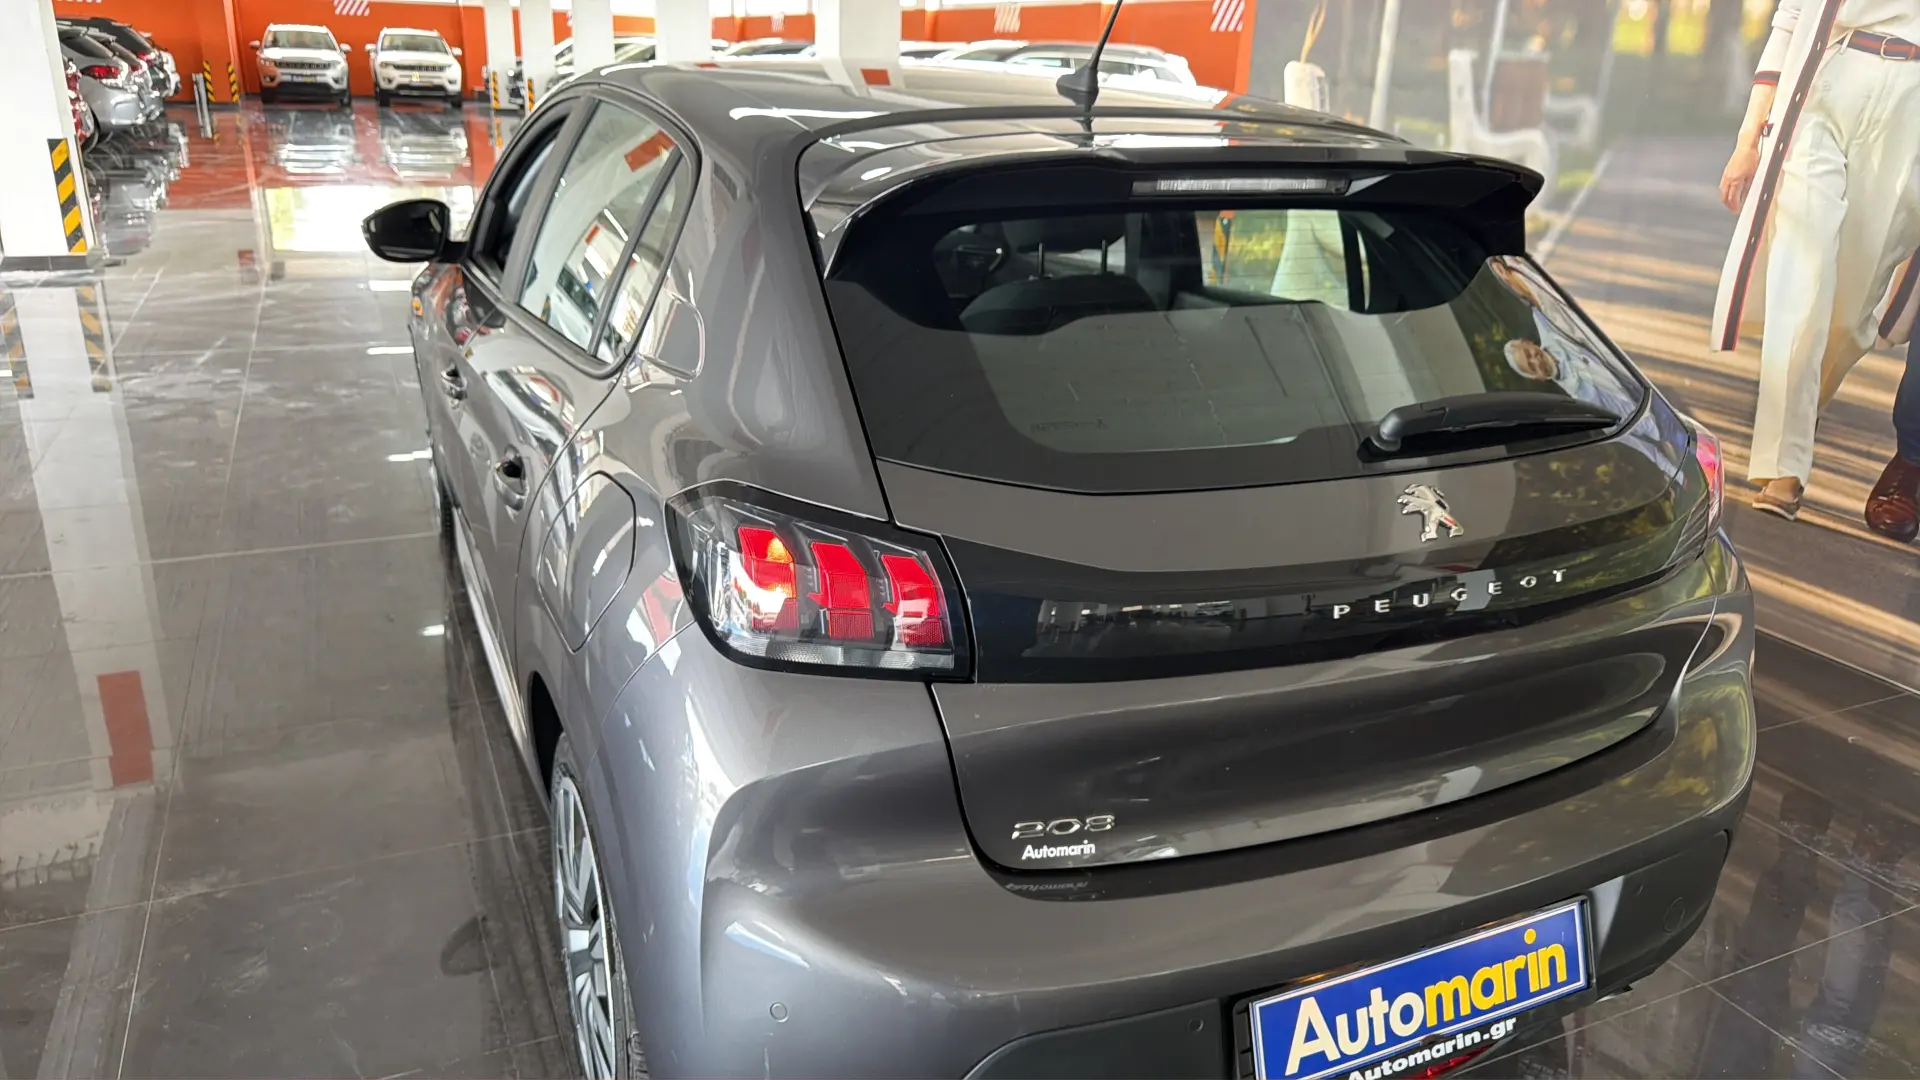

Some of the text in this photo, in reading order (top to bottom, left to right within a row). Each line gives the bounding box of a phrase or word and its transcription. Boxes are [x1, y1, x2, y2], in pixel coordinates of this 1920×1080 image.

[1333, 568, 1566, 619] PEUGEOT
[1011, 814, 1115, 840] 208
[1021, 839, 1096, 860] Automarin
[1285, 928, 1567, 1076] Automarin
